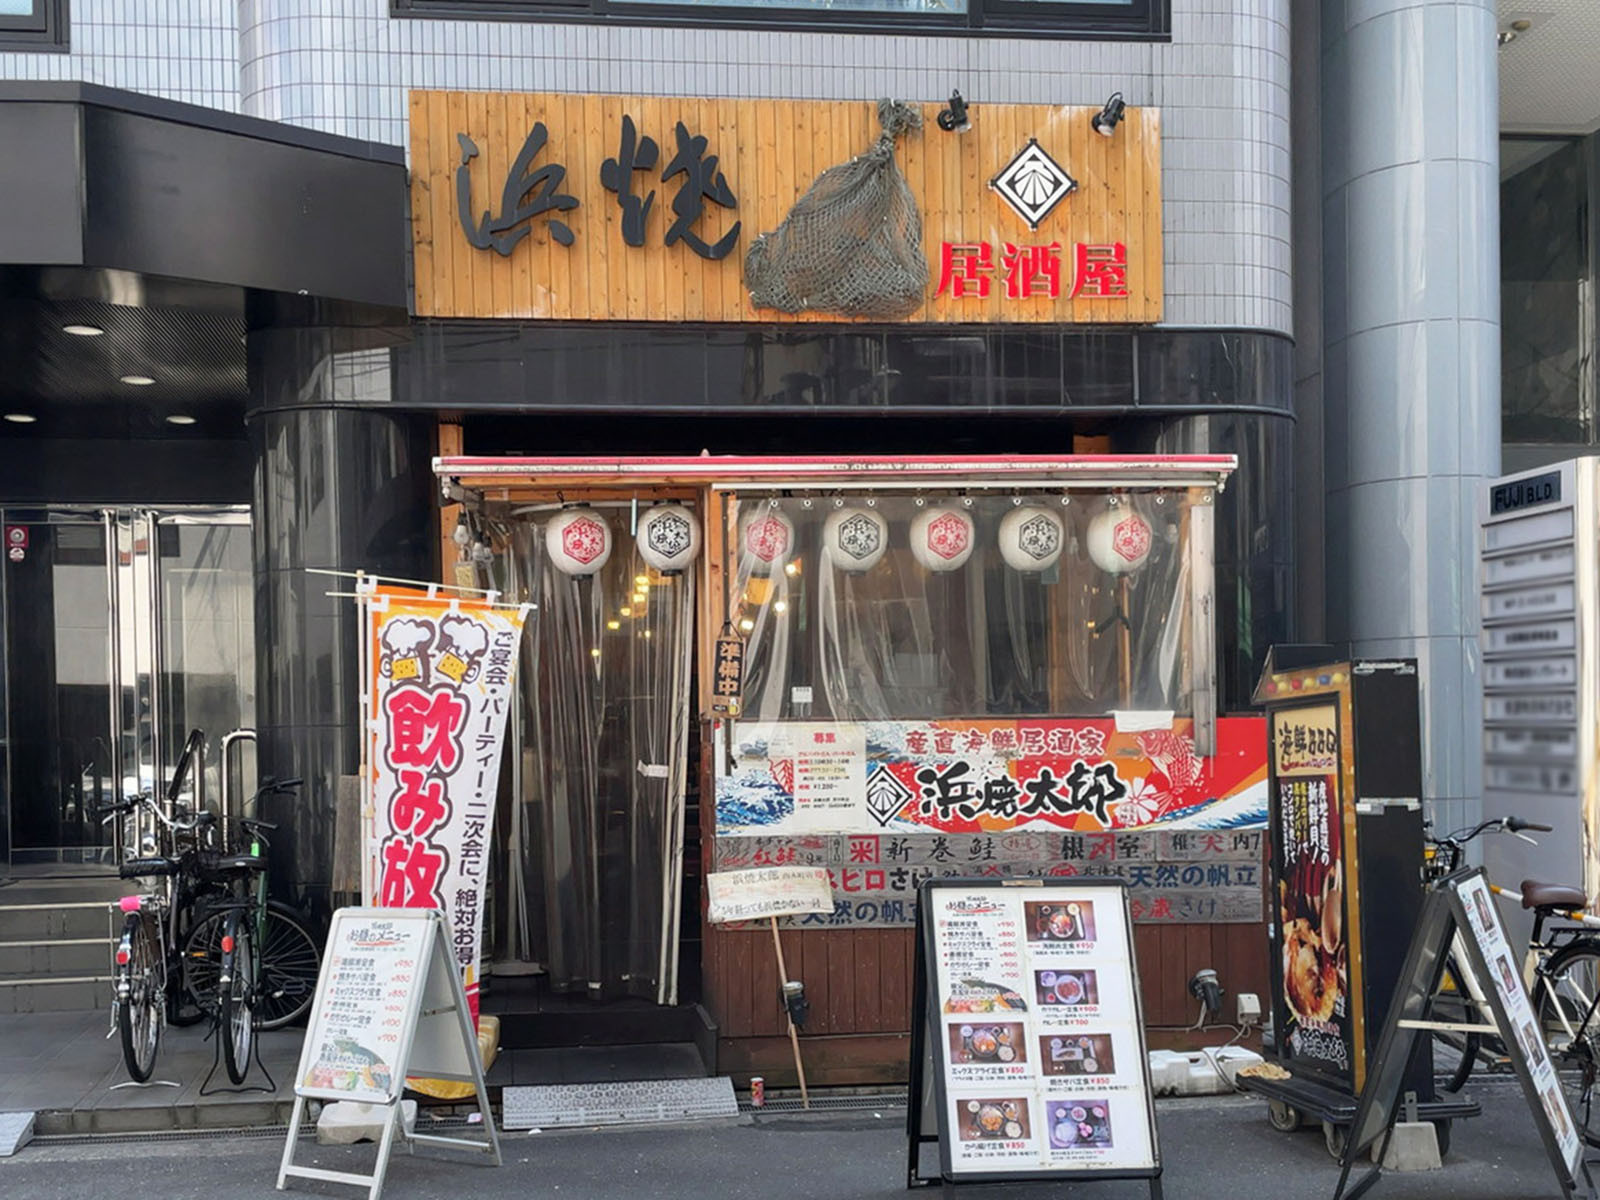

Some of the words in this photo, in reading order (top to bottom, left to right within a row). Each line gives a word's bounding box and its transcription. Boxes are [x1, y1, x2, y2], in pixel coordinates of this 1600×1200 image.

[457, 114, 741, 261] 浜焼
[935, 240, 1130, 302] 居酒屋
[1494, 484, 1524, 512] FUJI
[905, 728, 1105, 757] 産直海鮮居酒家
[916, 761, 1126, 825] 浜焼太郎
[885, 836, 998, 863] 新巻鮭
[1128, 865, 1257, 888] 天然の帆立
